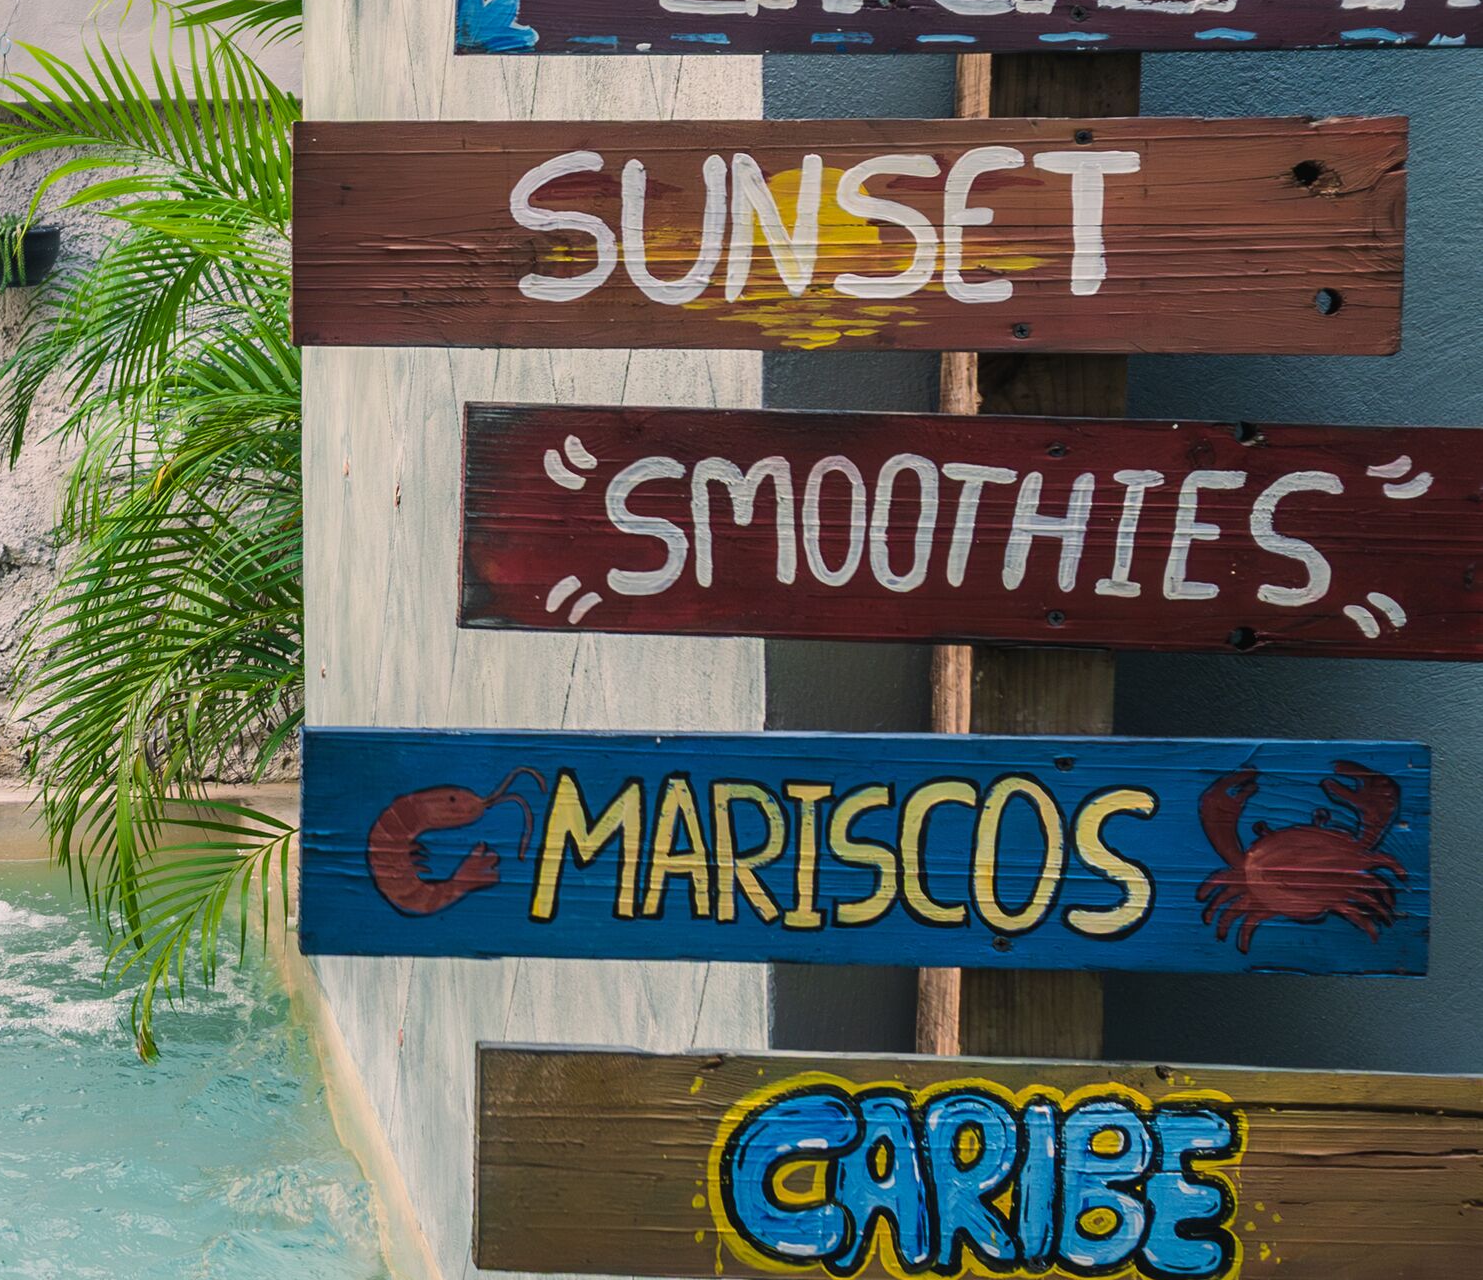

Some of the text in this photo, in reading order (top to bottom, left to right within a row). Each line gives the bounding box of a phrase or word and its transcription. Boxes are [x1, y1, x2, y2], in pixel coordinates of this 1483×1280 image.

[509, 145, 1141, 304] SUNSET
[604, 452, 1345, 607] SMOOTHIES
[528, 764, 1162, 943] MARISCOS
